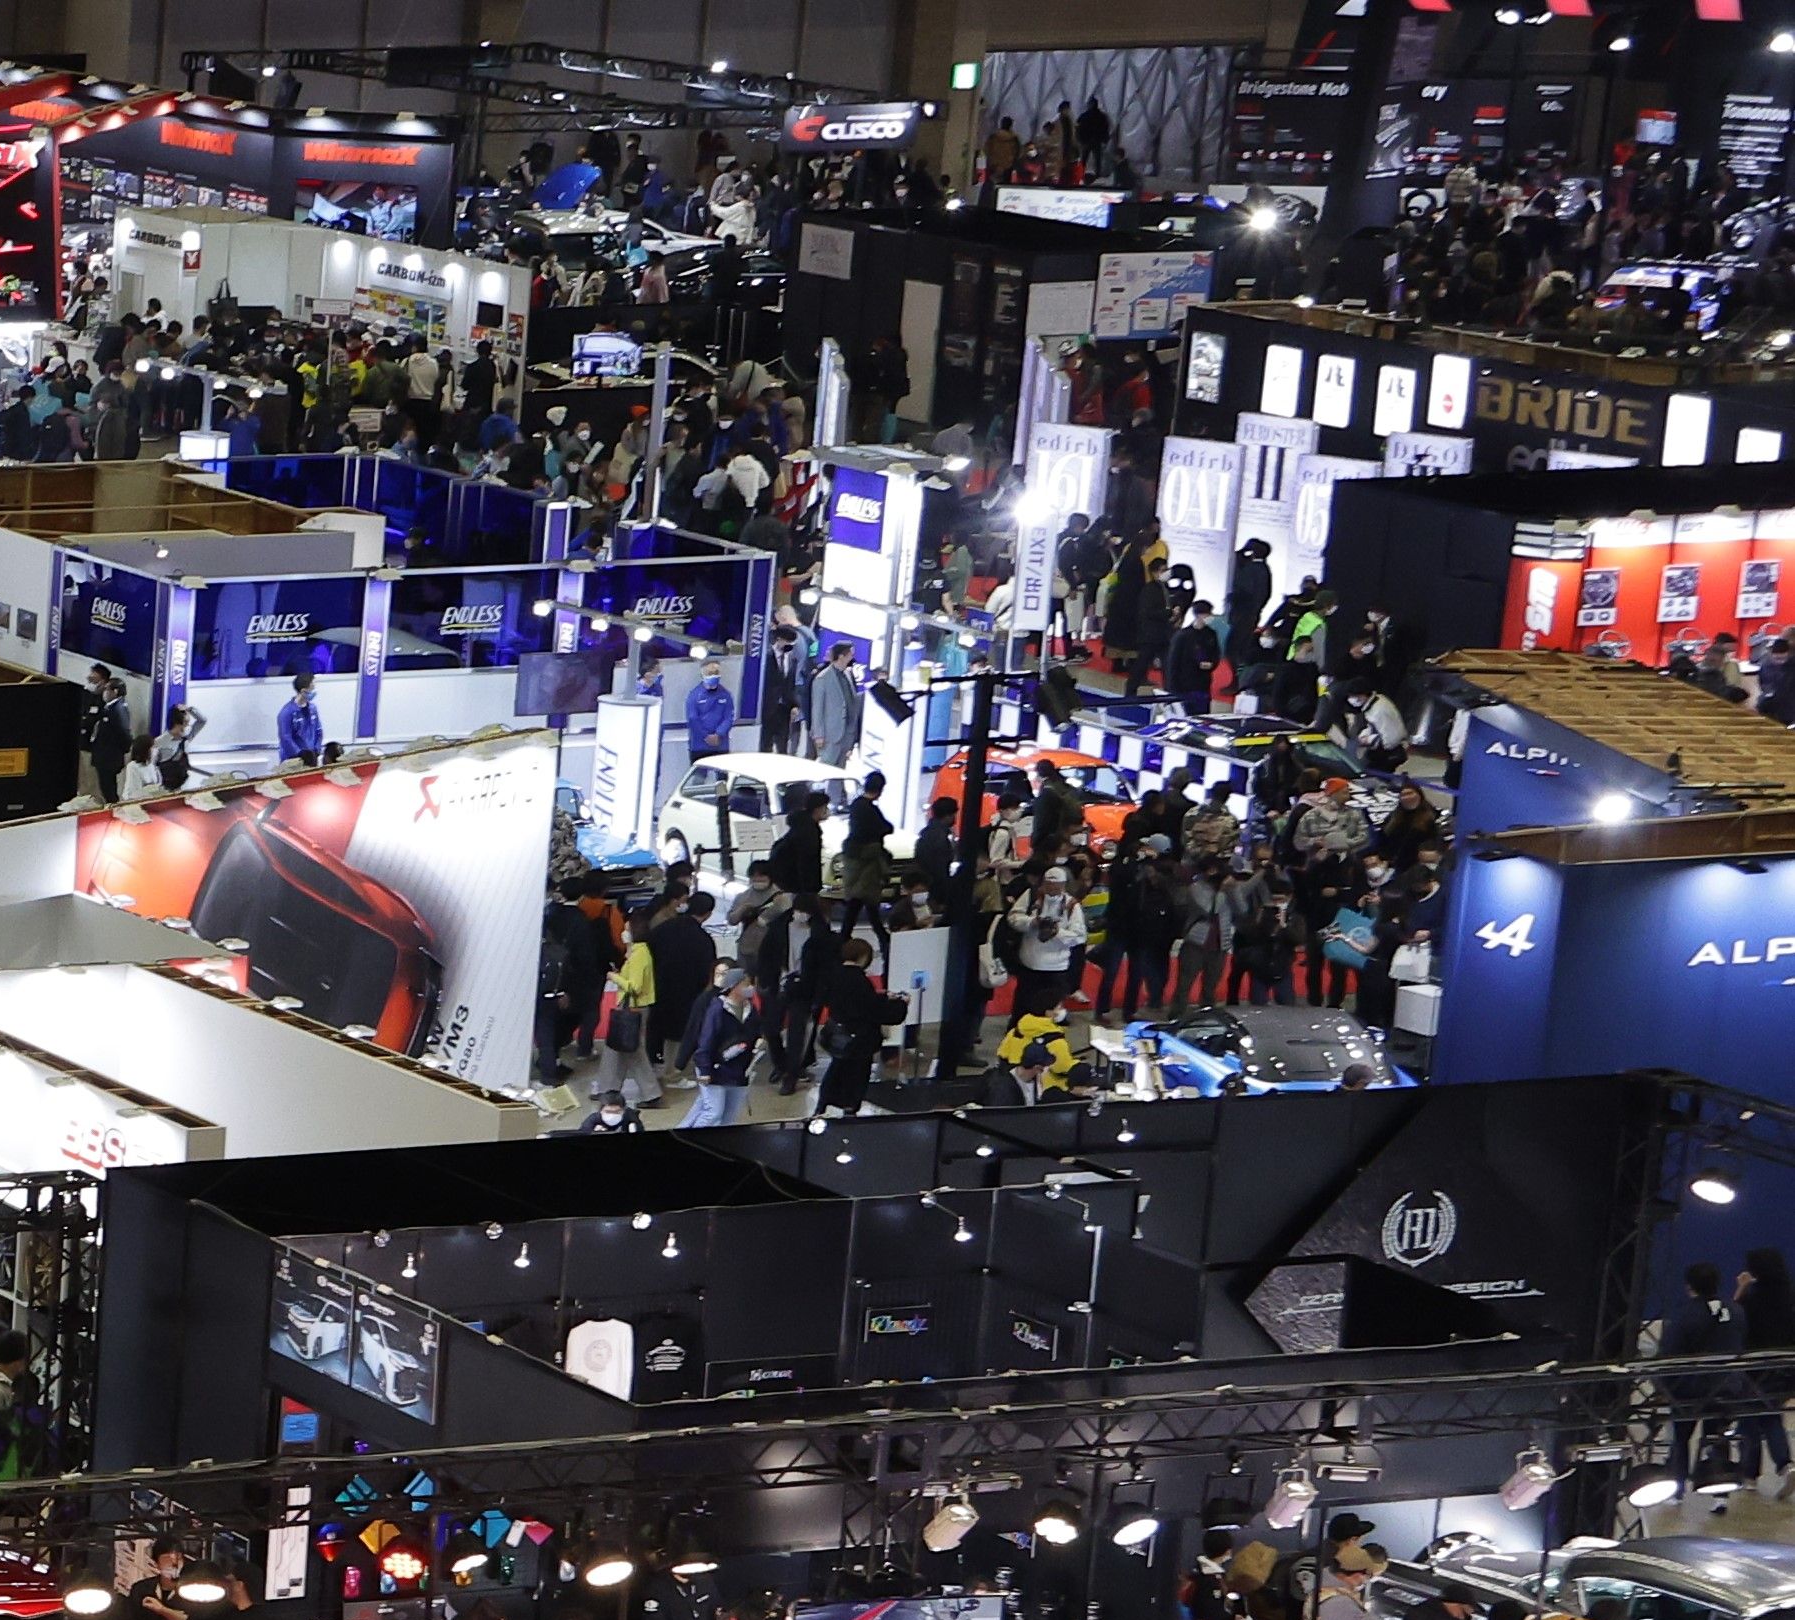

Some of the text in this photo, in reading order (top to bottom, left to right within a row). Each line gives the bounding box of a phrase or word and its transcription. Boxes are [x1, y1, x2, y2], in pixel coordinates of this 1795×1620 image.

[1238, 79, 1317, 96] Bridgestone
[821, 121, 905, 142] CUSCO
[376, 261, 447, 288] CARBON-izm
[1475, 375, 1651, 448] BRIDE
[1035, 434, 1099, 459] edirb
[1168, 450, 1233, 476] edirb
[91, 597, 128, 622] ENDLESS
[441, 604, 505, 625] ENDLESS
[634, 596, 695, 615] ENDLESS
[247, 613, 311, 634] ENDLESS
[60, 1119, 127, 1171] BBS
